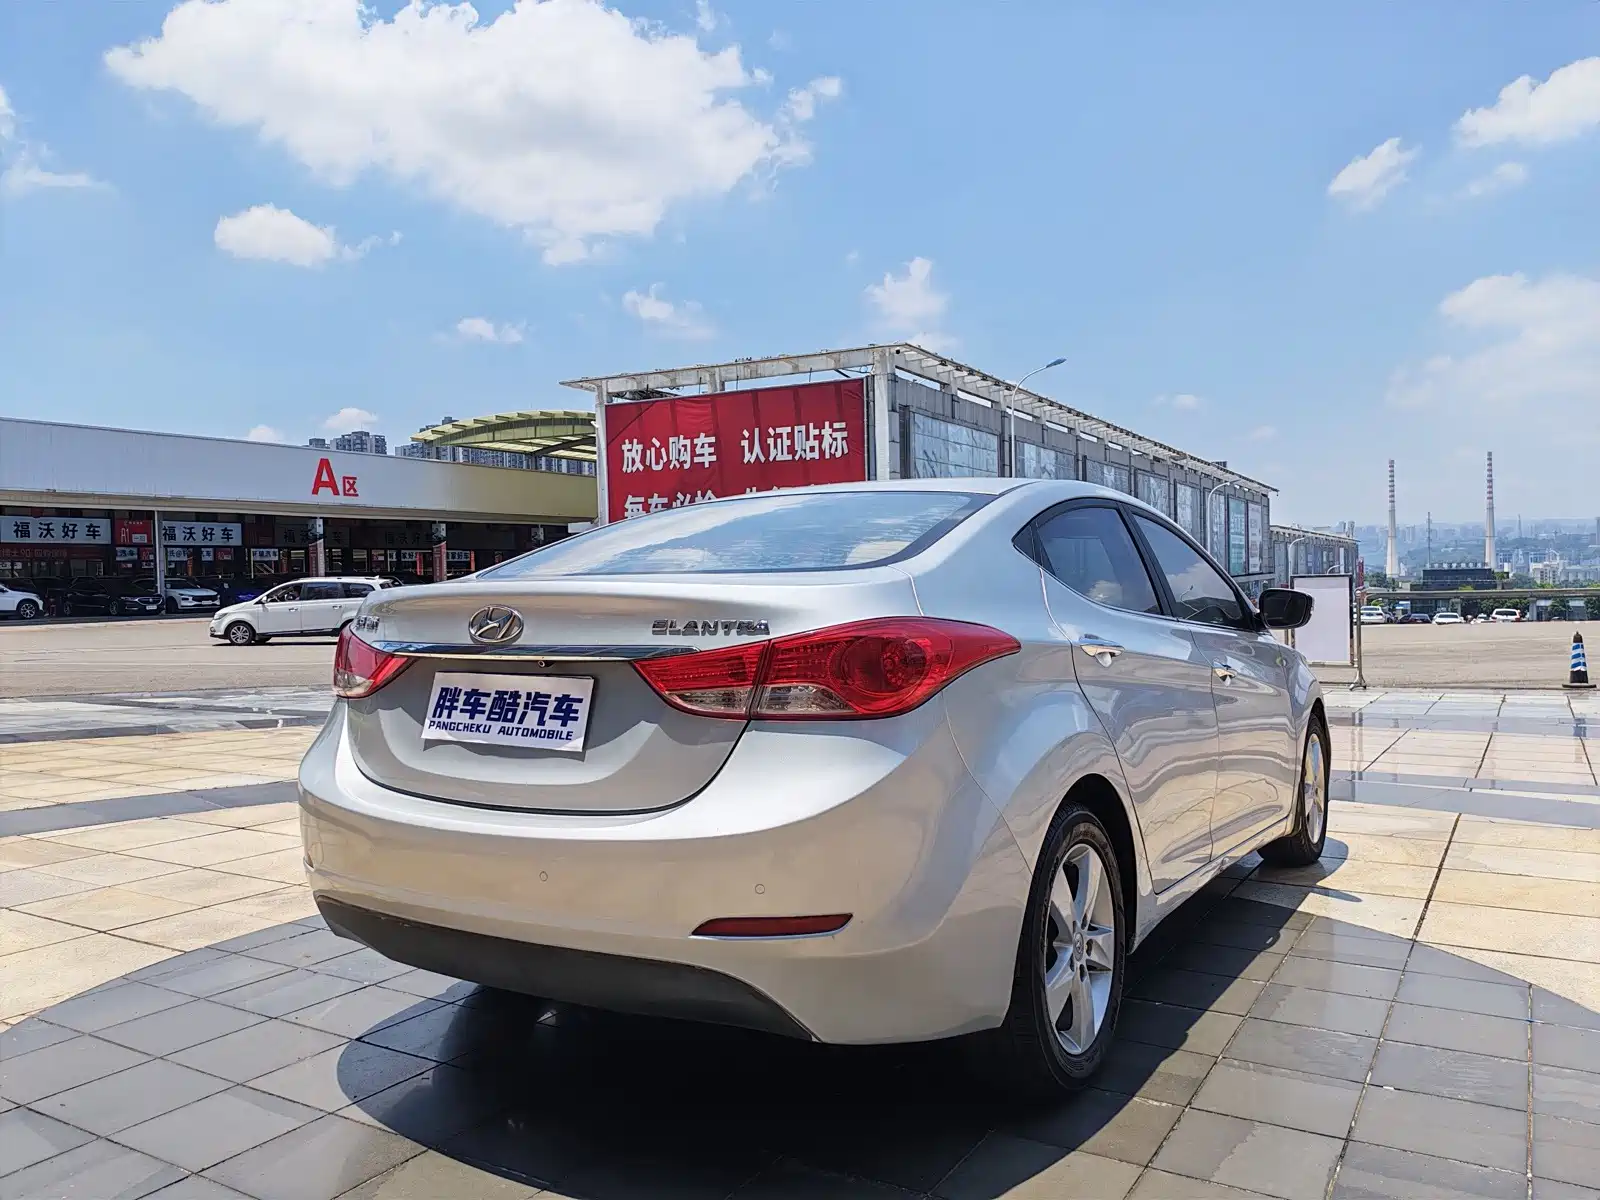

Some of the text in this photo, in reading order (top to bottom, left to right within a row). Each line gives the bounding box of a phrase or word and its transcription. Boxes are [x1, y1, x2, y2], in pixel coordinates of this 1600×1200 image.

[621, 421, 849, 473] 放心购车 认证贴标
[312, 458, 359, 497] A区
[13, 521, 102, 539] 福沃好车
[162, 524, 235, 542] 福沃好车
[652, 618, 770, 637] ELANTRA
[433, 686, 584, 728] 胖车酷汽车
[428, 721, 574, 742] PANGCHEKU AUTOMOBILE
